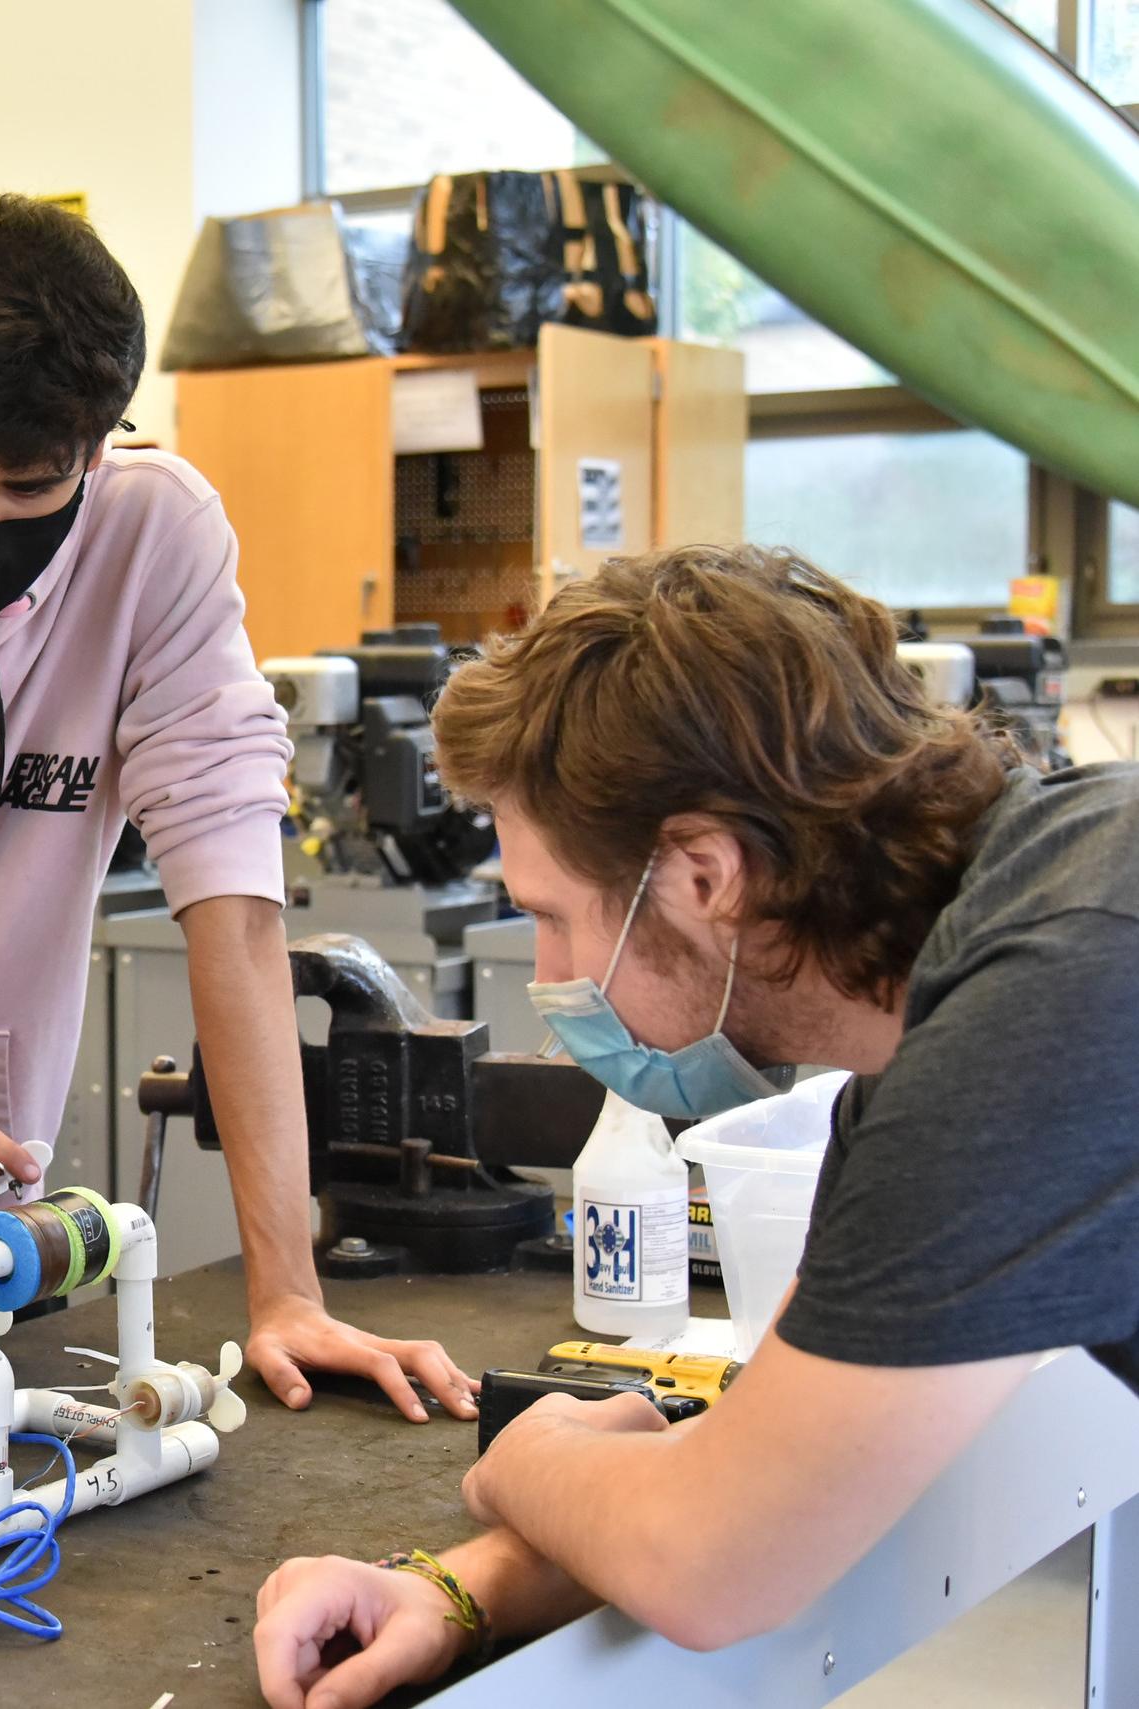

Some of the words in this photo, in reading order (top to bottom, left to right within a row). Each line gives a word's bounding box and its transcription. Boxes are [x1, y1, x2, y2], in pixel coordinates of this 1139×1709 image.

[6, 752, 101, 785] ERICAN
[589, 1280, 603, 1293] Hand
[605, 1282, 634, 1295] Sanitizer
[86, 1467, 118, 1496] 4.5
